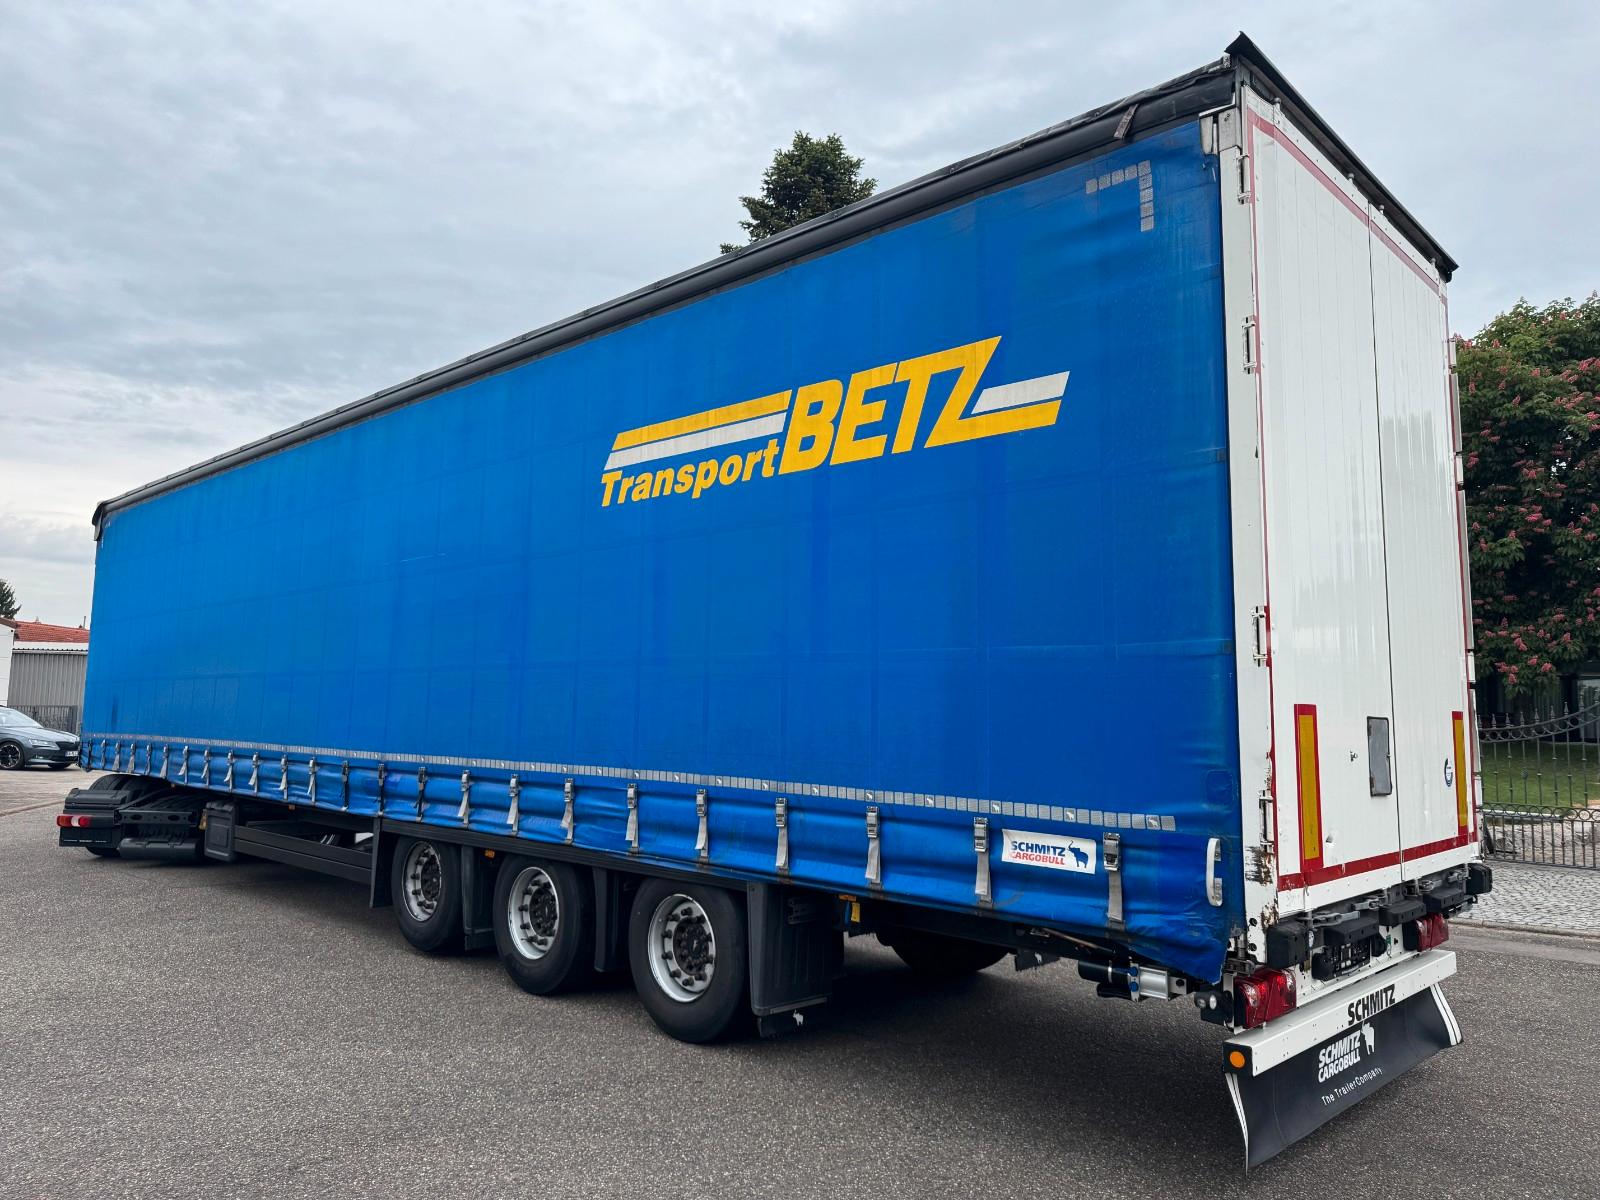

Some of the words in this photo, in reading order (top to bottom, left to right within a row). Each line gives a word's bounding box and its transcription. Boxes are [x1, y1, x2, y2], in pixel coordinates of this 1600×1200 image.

[601, 441, 778, 507] Transport
[779, 336, 1061, 475] BETZ
[1011, 840, 1066, 857] SCHMITZ
[1348, 984, 1395, 1026] SCHMITZ
[1318, 1030, 1361, 1068] SCHMITZ
[1318, 1049, 1361, 1083] CARGOBULL
[1321, 1094, 1335, 1106] The
